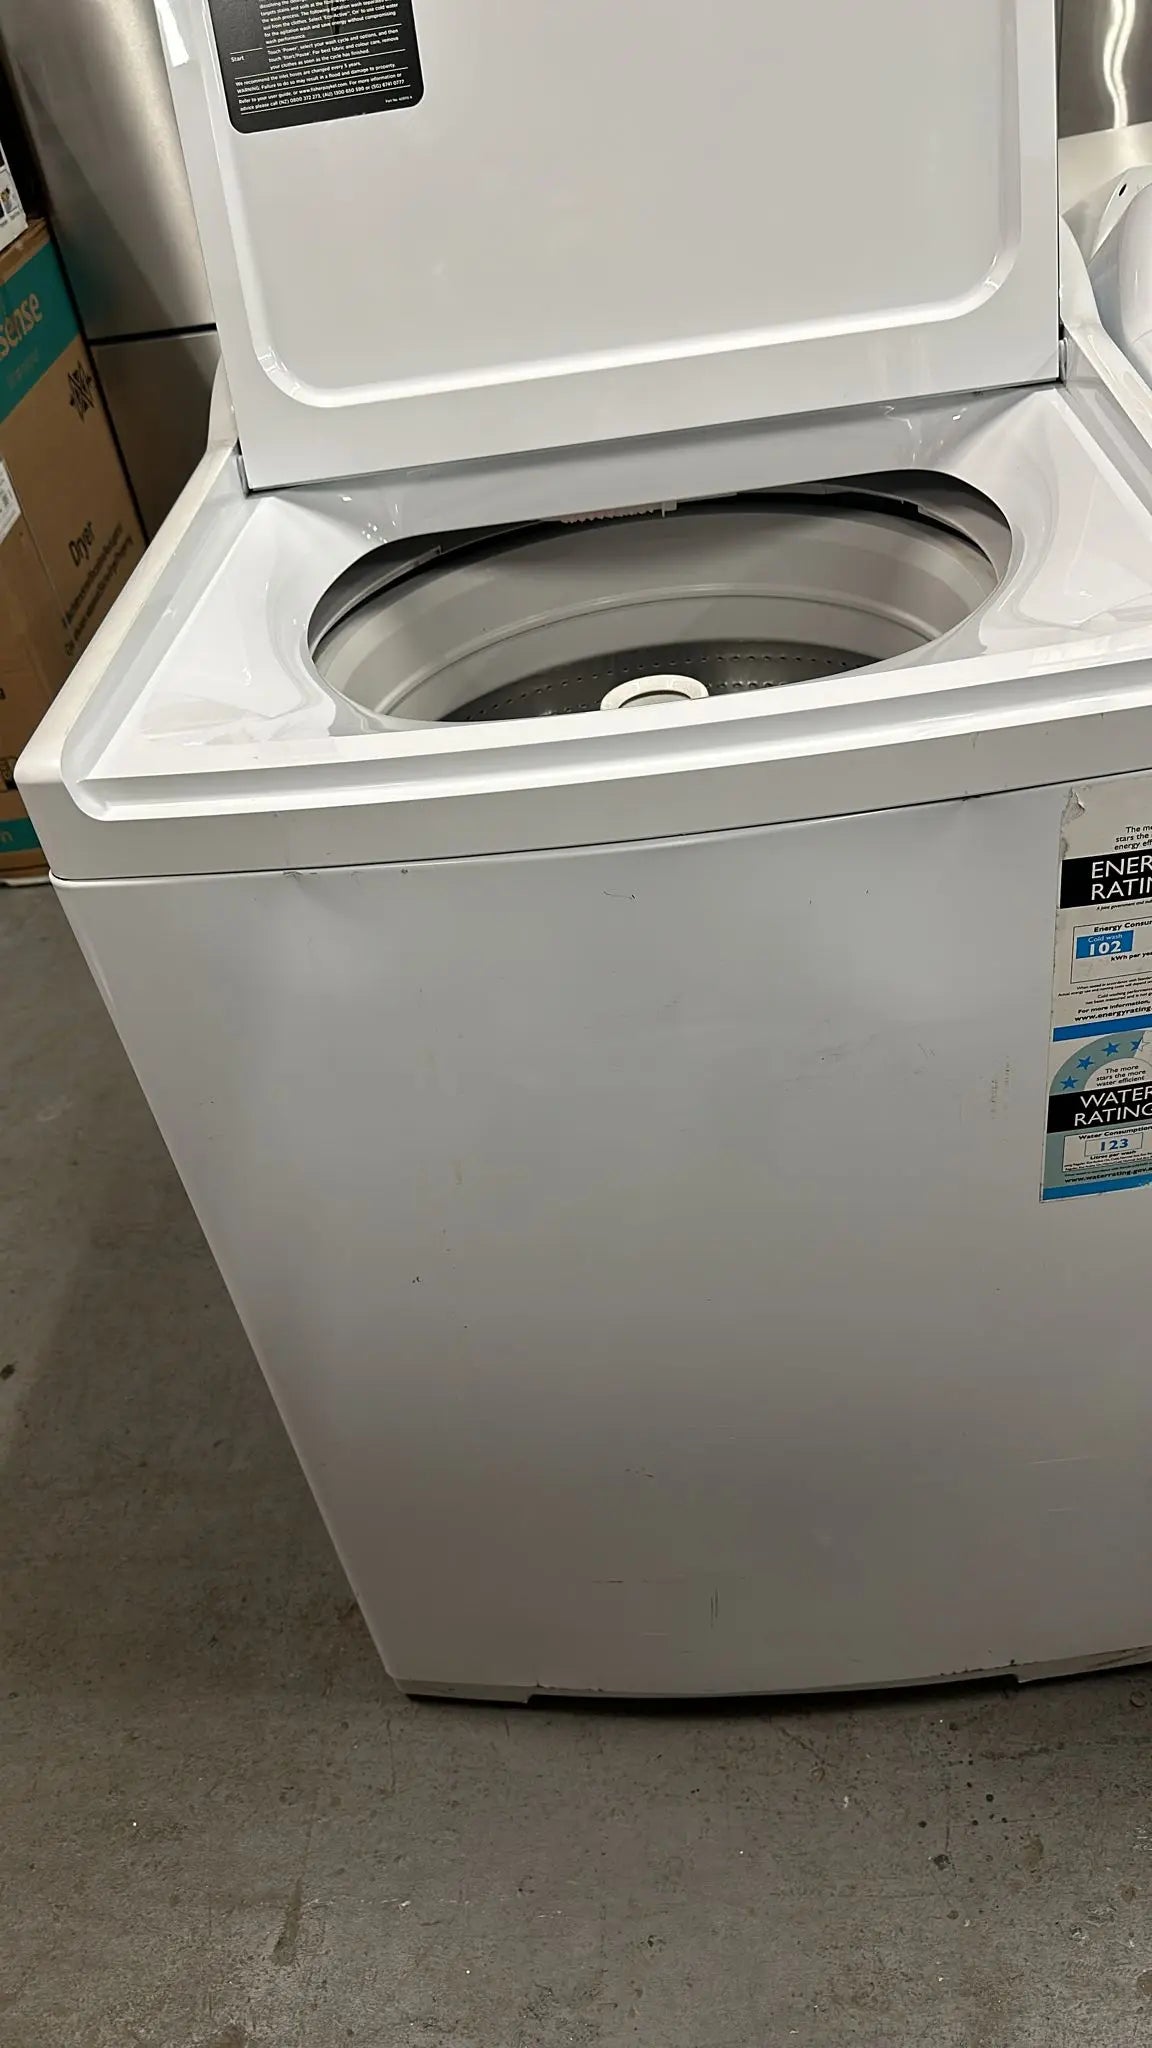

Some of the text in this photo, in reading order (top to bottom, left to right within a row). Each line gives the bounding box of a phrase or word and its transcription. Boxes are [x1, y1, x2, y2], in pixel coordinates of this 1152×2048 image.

[69, 521, 95, 566] Dryer
[1090, 941, 1121, 955] 102
[1110, 1000, 1150, 1008] information,
[1080, 1086, 1152, 1108] WATER
[1075, 1102, 1152, 1126] RATING
[1104, 1126, 1152, 1137] Consumption
[1101, 1139, 1128, 1152] 123
